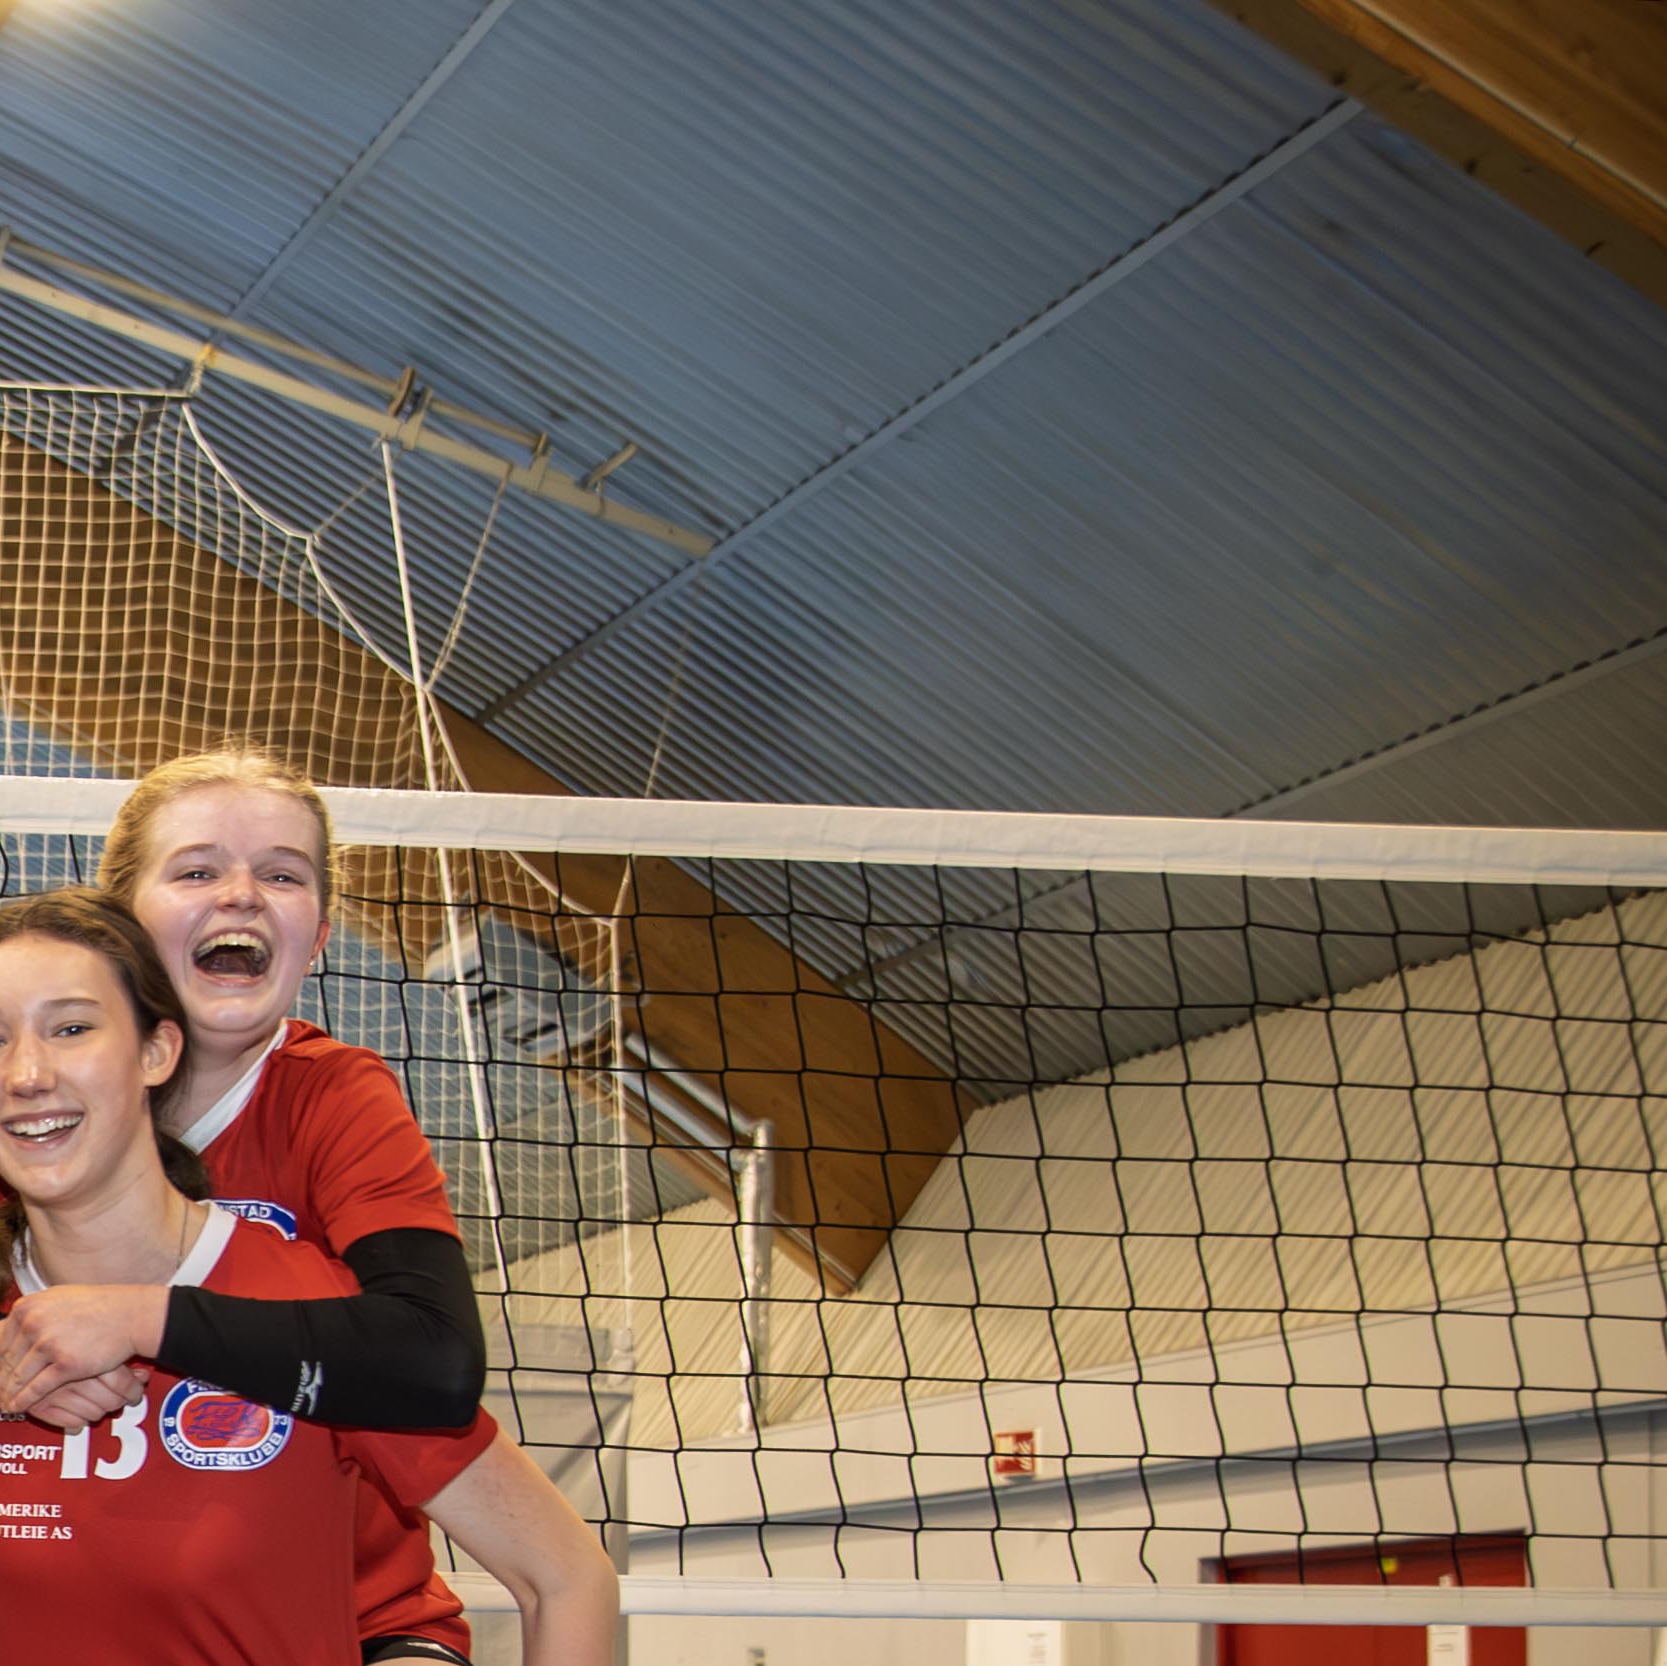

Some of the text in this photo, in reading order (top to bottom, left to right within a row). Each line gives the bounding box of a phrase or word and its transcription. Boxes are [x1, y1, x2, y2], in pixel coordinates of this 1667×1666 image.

[213, 1206, 271, 1220] NSTAD
[60, 1392, 149, 1480] 13
[167, 1432, 283, 1466] SPORTSKLUBB
[50, 1526, 73, 1540] AS
